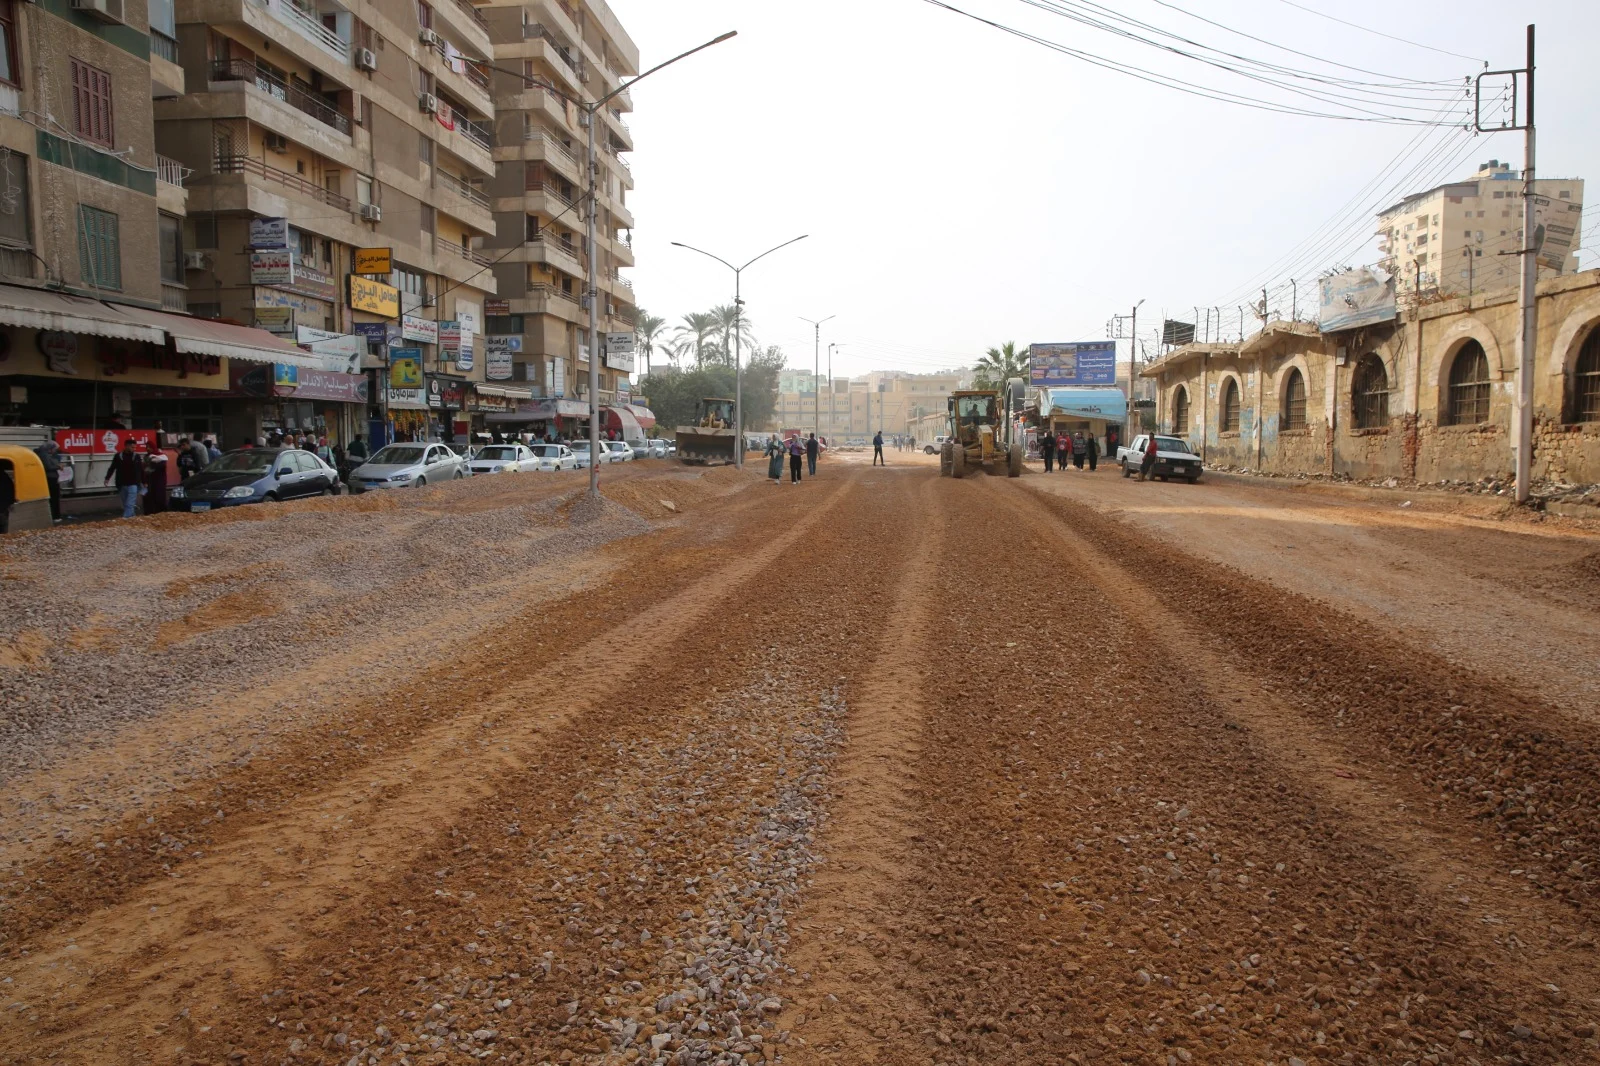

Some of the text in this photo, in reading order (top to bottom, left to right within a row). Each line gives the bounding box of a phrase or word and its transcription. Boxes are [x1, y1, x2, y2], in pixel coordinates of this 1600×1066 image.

[307, 272, 326, 284] محمد
[357, 282, 398, 304] معامل البرج
[324, 376, 349, 392] صيدلية
[64, 433, 94, 449] الشام
